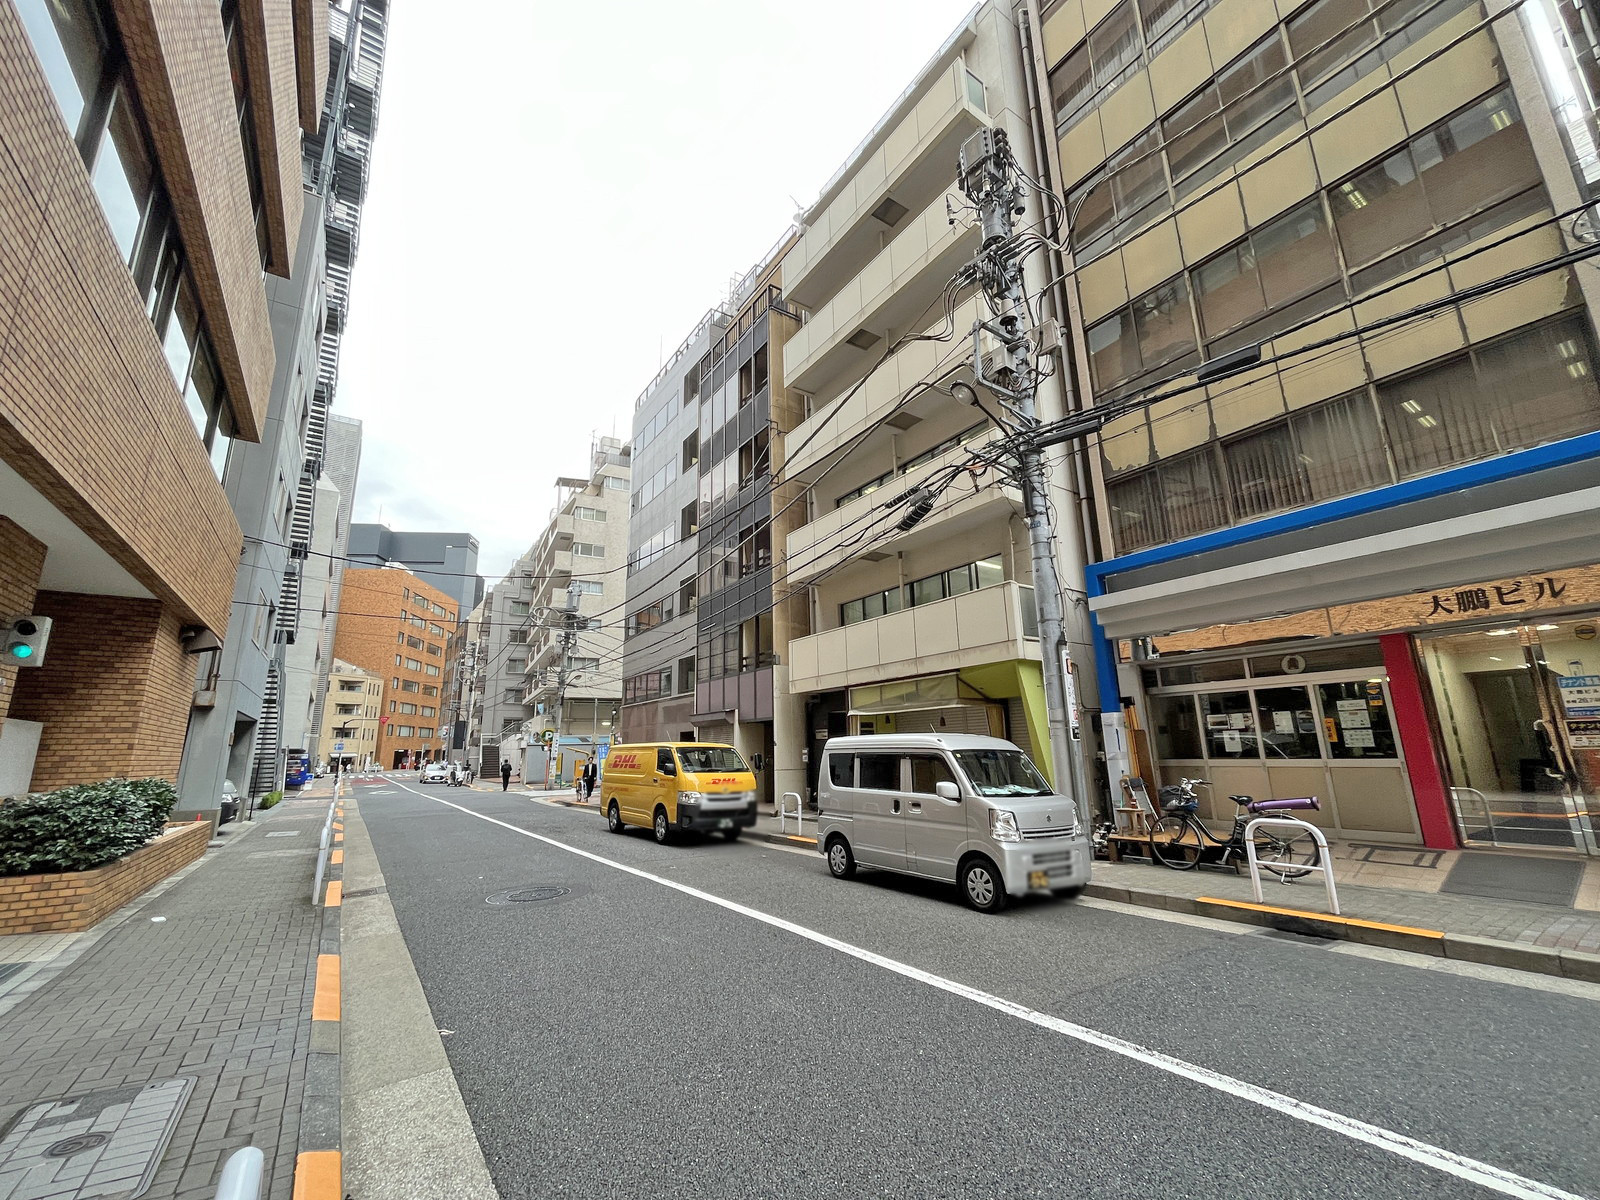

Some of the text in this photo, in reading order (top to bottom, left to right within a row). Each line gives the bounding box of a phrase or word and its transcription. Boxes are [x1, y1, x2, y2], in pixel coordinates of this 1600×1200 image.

[1426, 578, 1566, 617] 大鵬ビル
[545, 731, 553, 741] P
[611, 754, 637, 768] DHL
